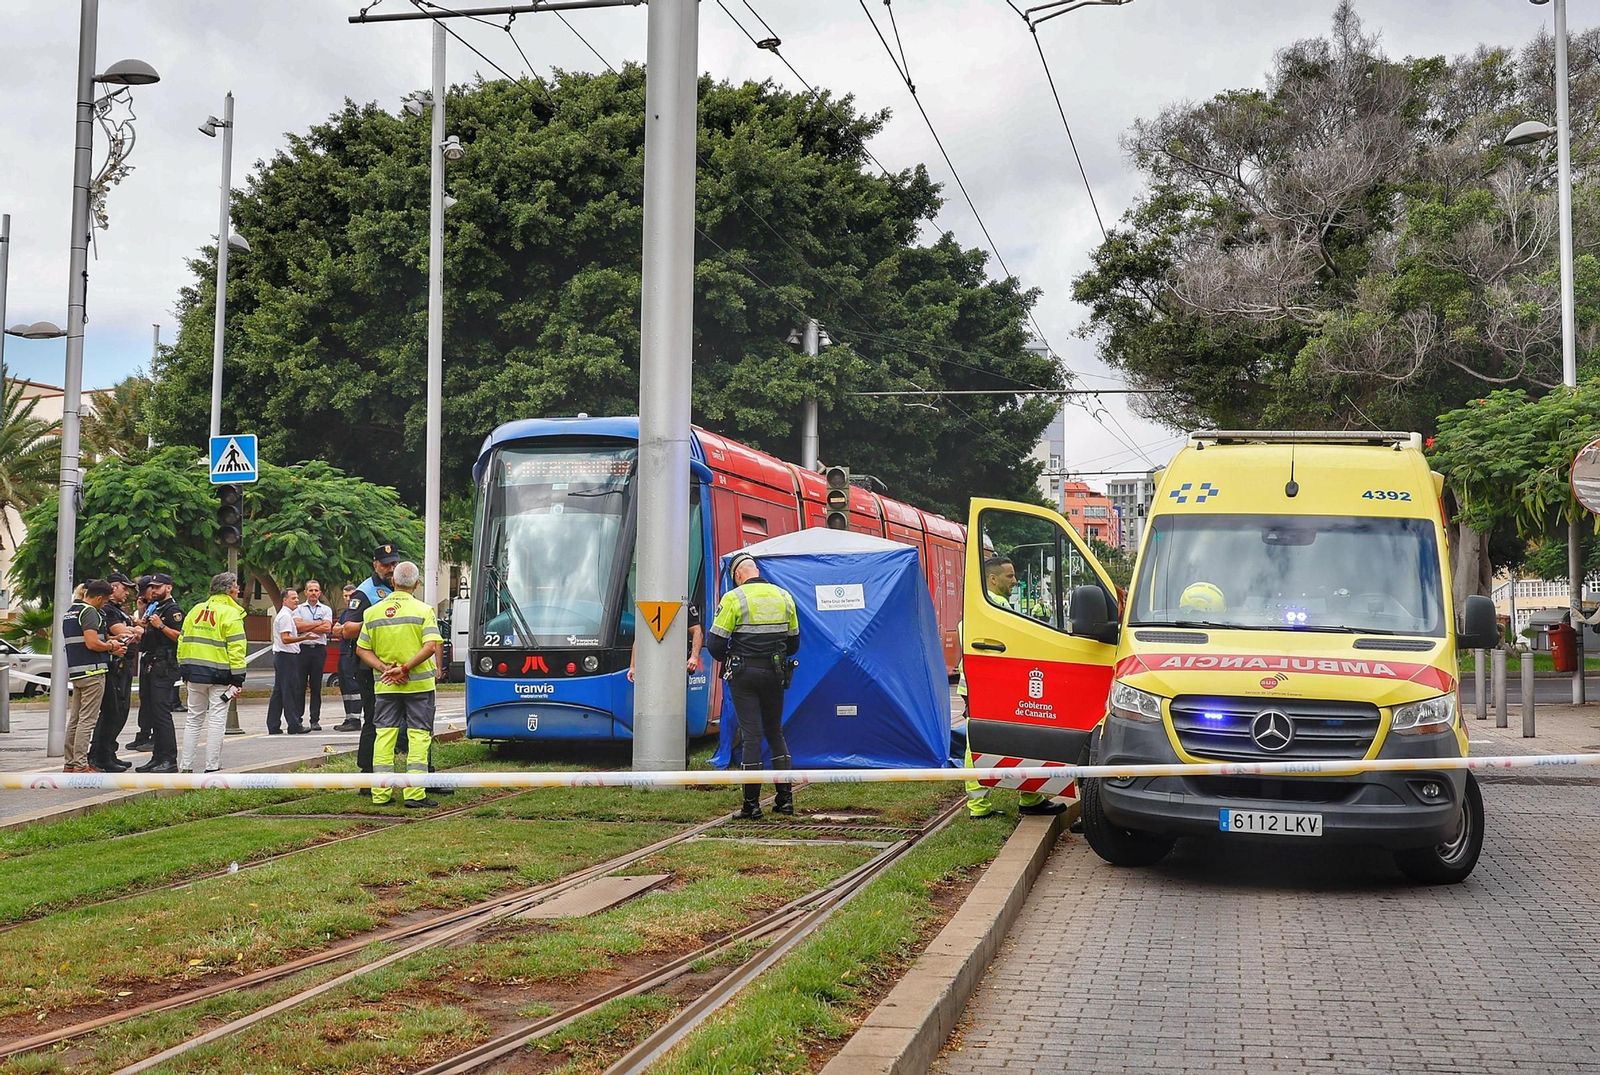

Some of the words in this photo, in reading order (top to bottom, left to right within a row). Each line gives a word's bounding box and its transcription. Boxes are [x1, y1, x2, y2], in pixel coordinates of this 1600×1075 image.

[1362, 490, 1412, 501] 4392
[484, 635, 500, 647] 22
[1018, 701, 1053, 710] Gobierno
[1024, 709, 1057, 719] Canarias
[1234, 813, 1278, 831] 6112
[1284, 816, 1318, 832] LKV
